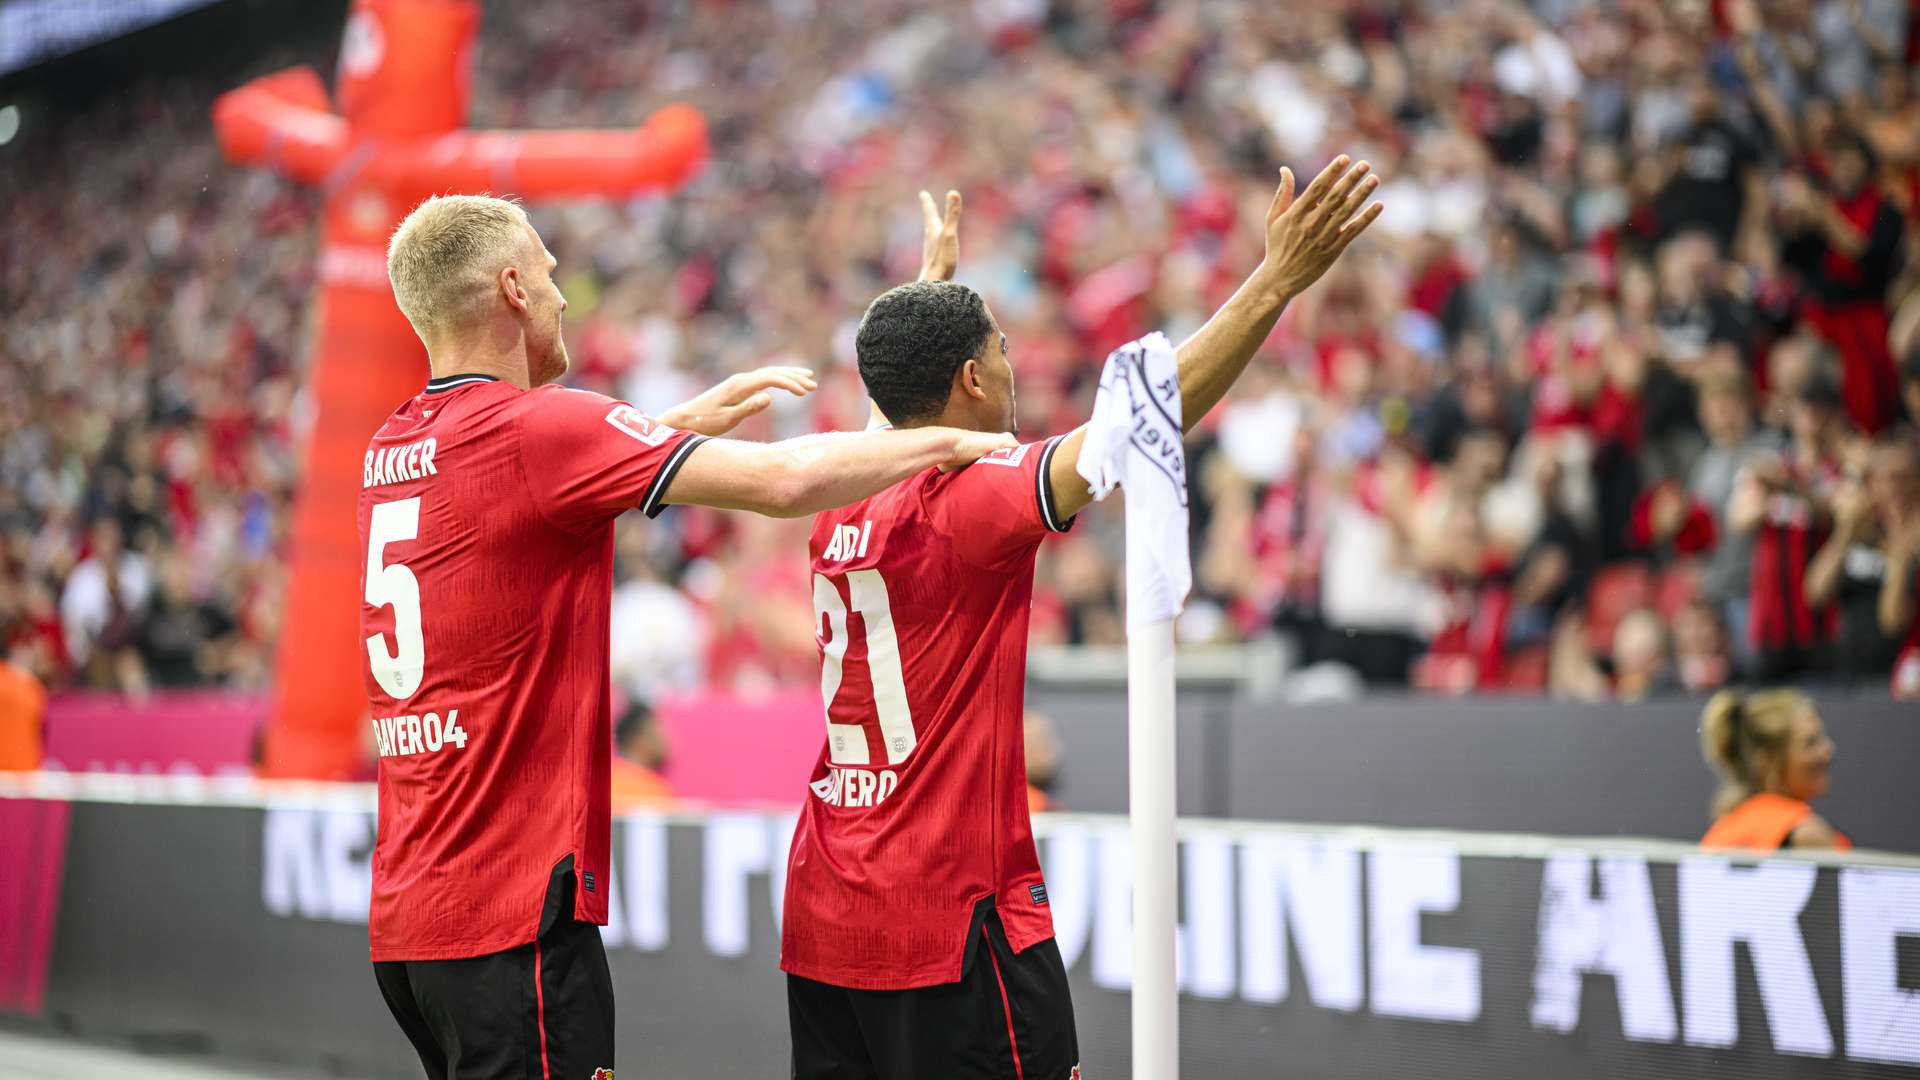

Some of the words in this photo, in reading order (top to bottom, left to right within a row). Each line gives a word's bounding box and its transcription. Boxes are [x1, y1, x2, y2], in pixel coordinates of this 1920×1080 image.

[364, 438, 437, 488] BAKKER
[364, 496, 424, 699] 5
[823, 520, 873, 562] ADI
[814, 569, 917, 765] 21
